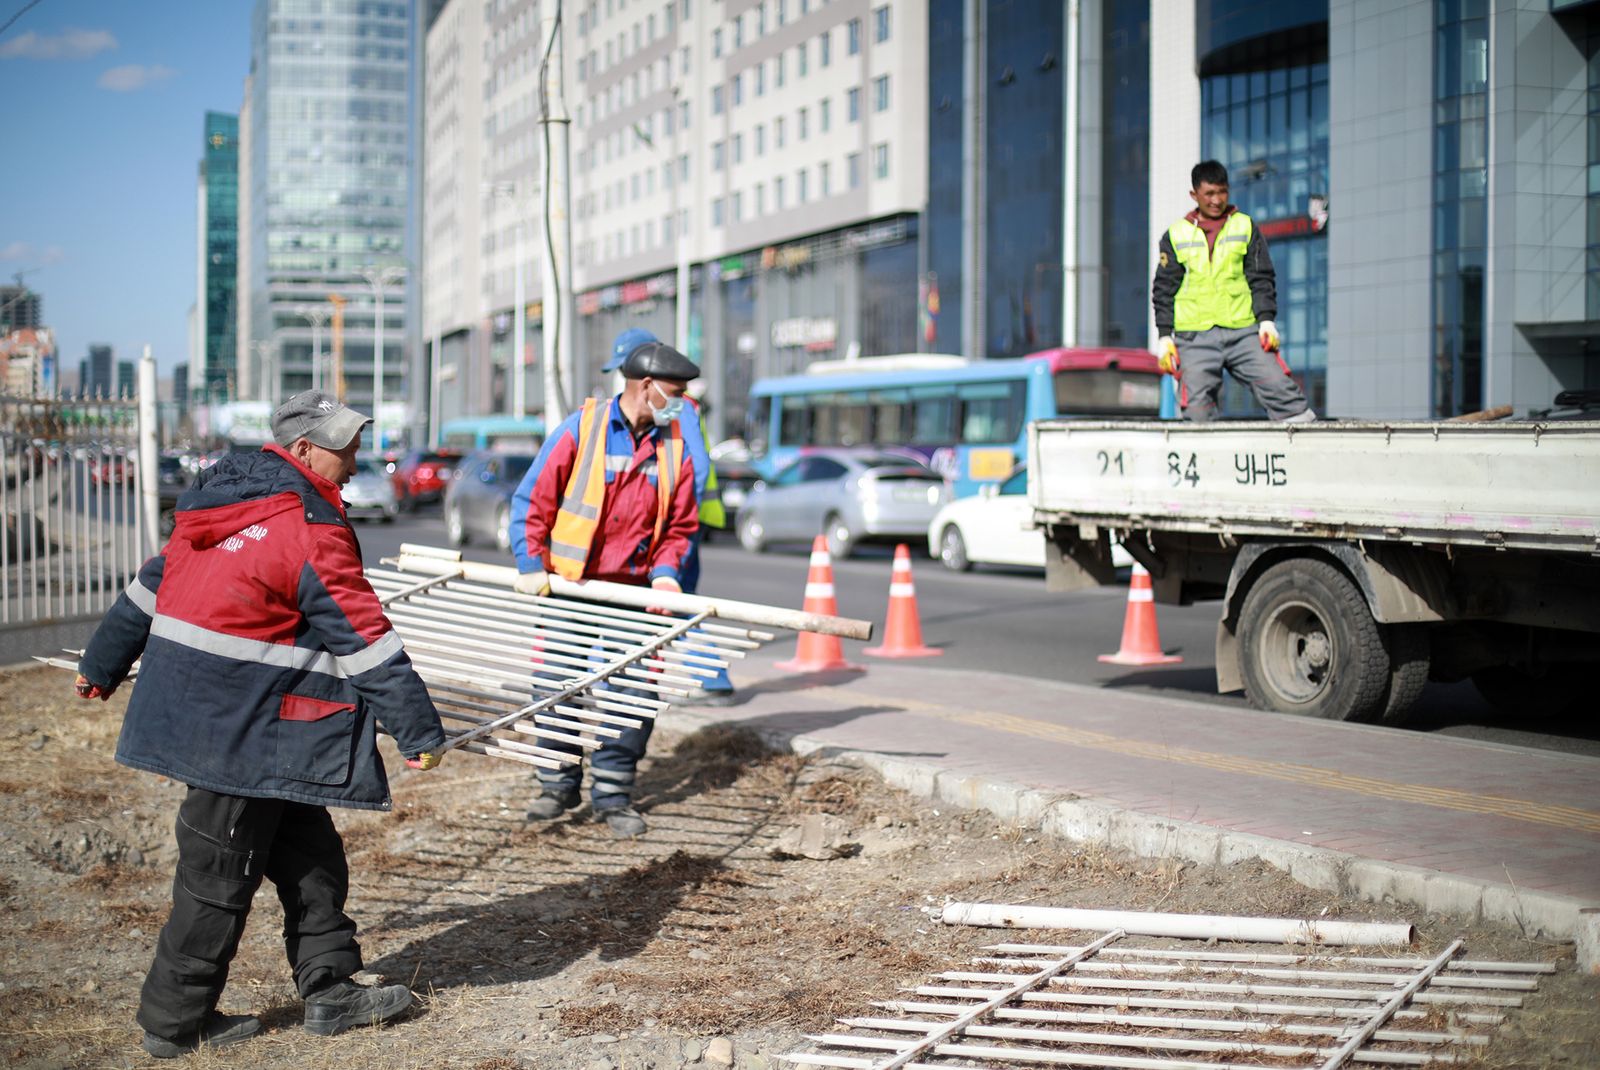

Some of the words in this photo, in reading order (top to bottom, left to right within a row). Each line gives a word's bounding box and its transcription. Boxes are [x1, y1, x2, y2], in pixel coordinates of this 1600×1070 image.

[1167, 452, 1201, 487] 84
[1234, 453, 1287, 486] УНБ
[239, 525, 268, 541] АСВАР
